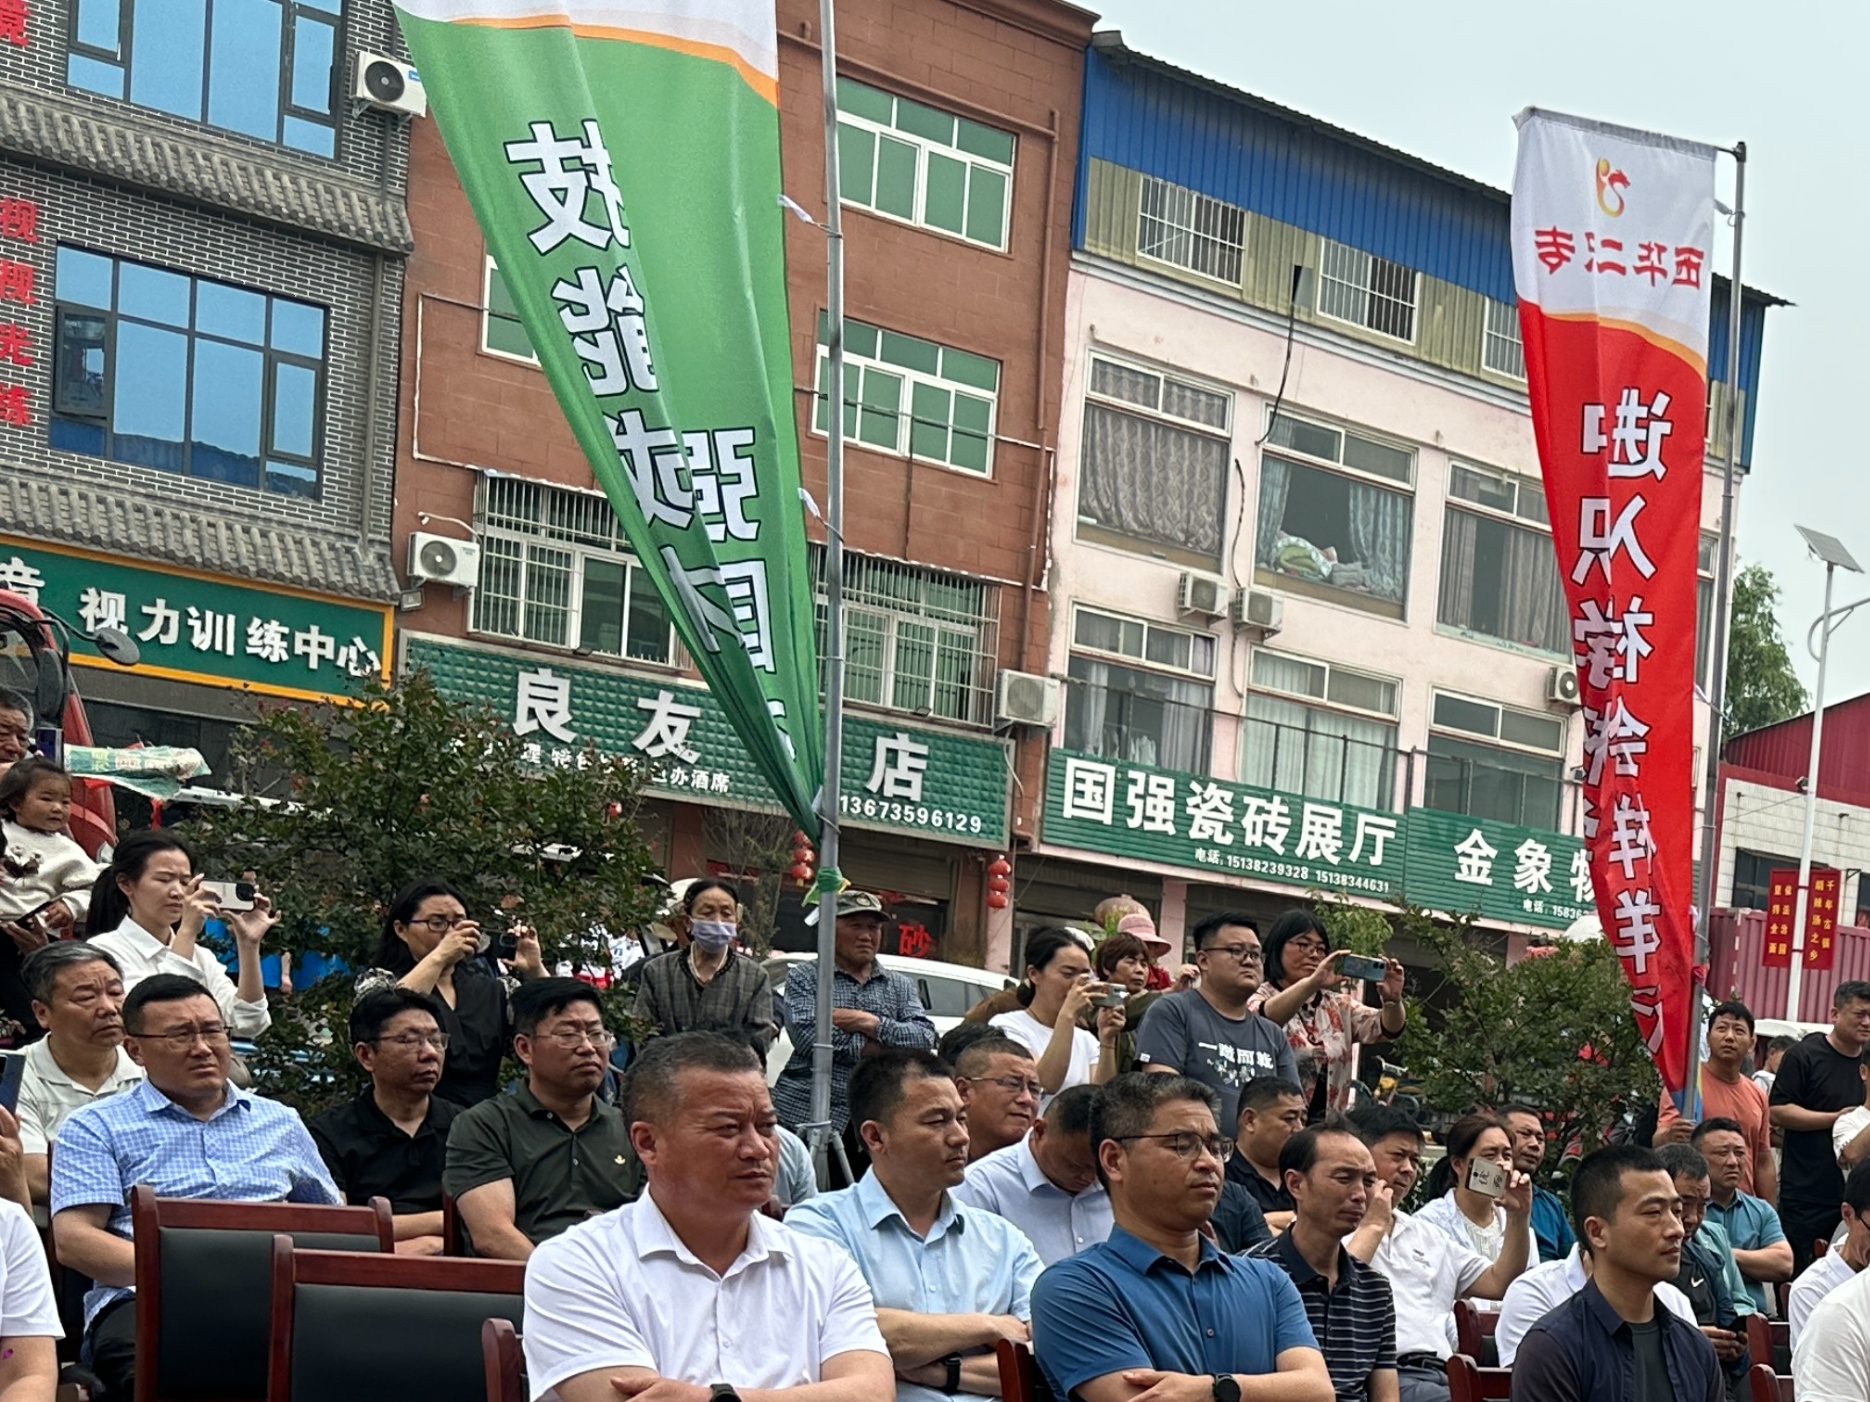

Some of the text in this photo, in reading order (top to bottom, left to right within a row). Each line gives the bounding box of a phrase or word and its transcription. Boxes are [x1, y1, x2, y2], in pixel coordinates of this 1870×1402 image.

[78, 587, 381, 677] 视力训练中心
[839, 795, 983, 834] 13673596129
[1062, 757, 1398, 867] 国强瓷砖展厅
[1314, 869, 1390, 894] 15138344631
